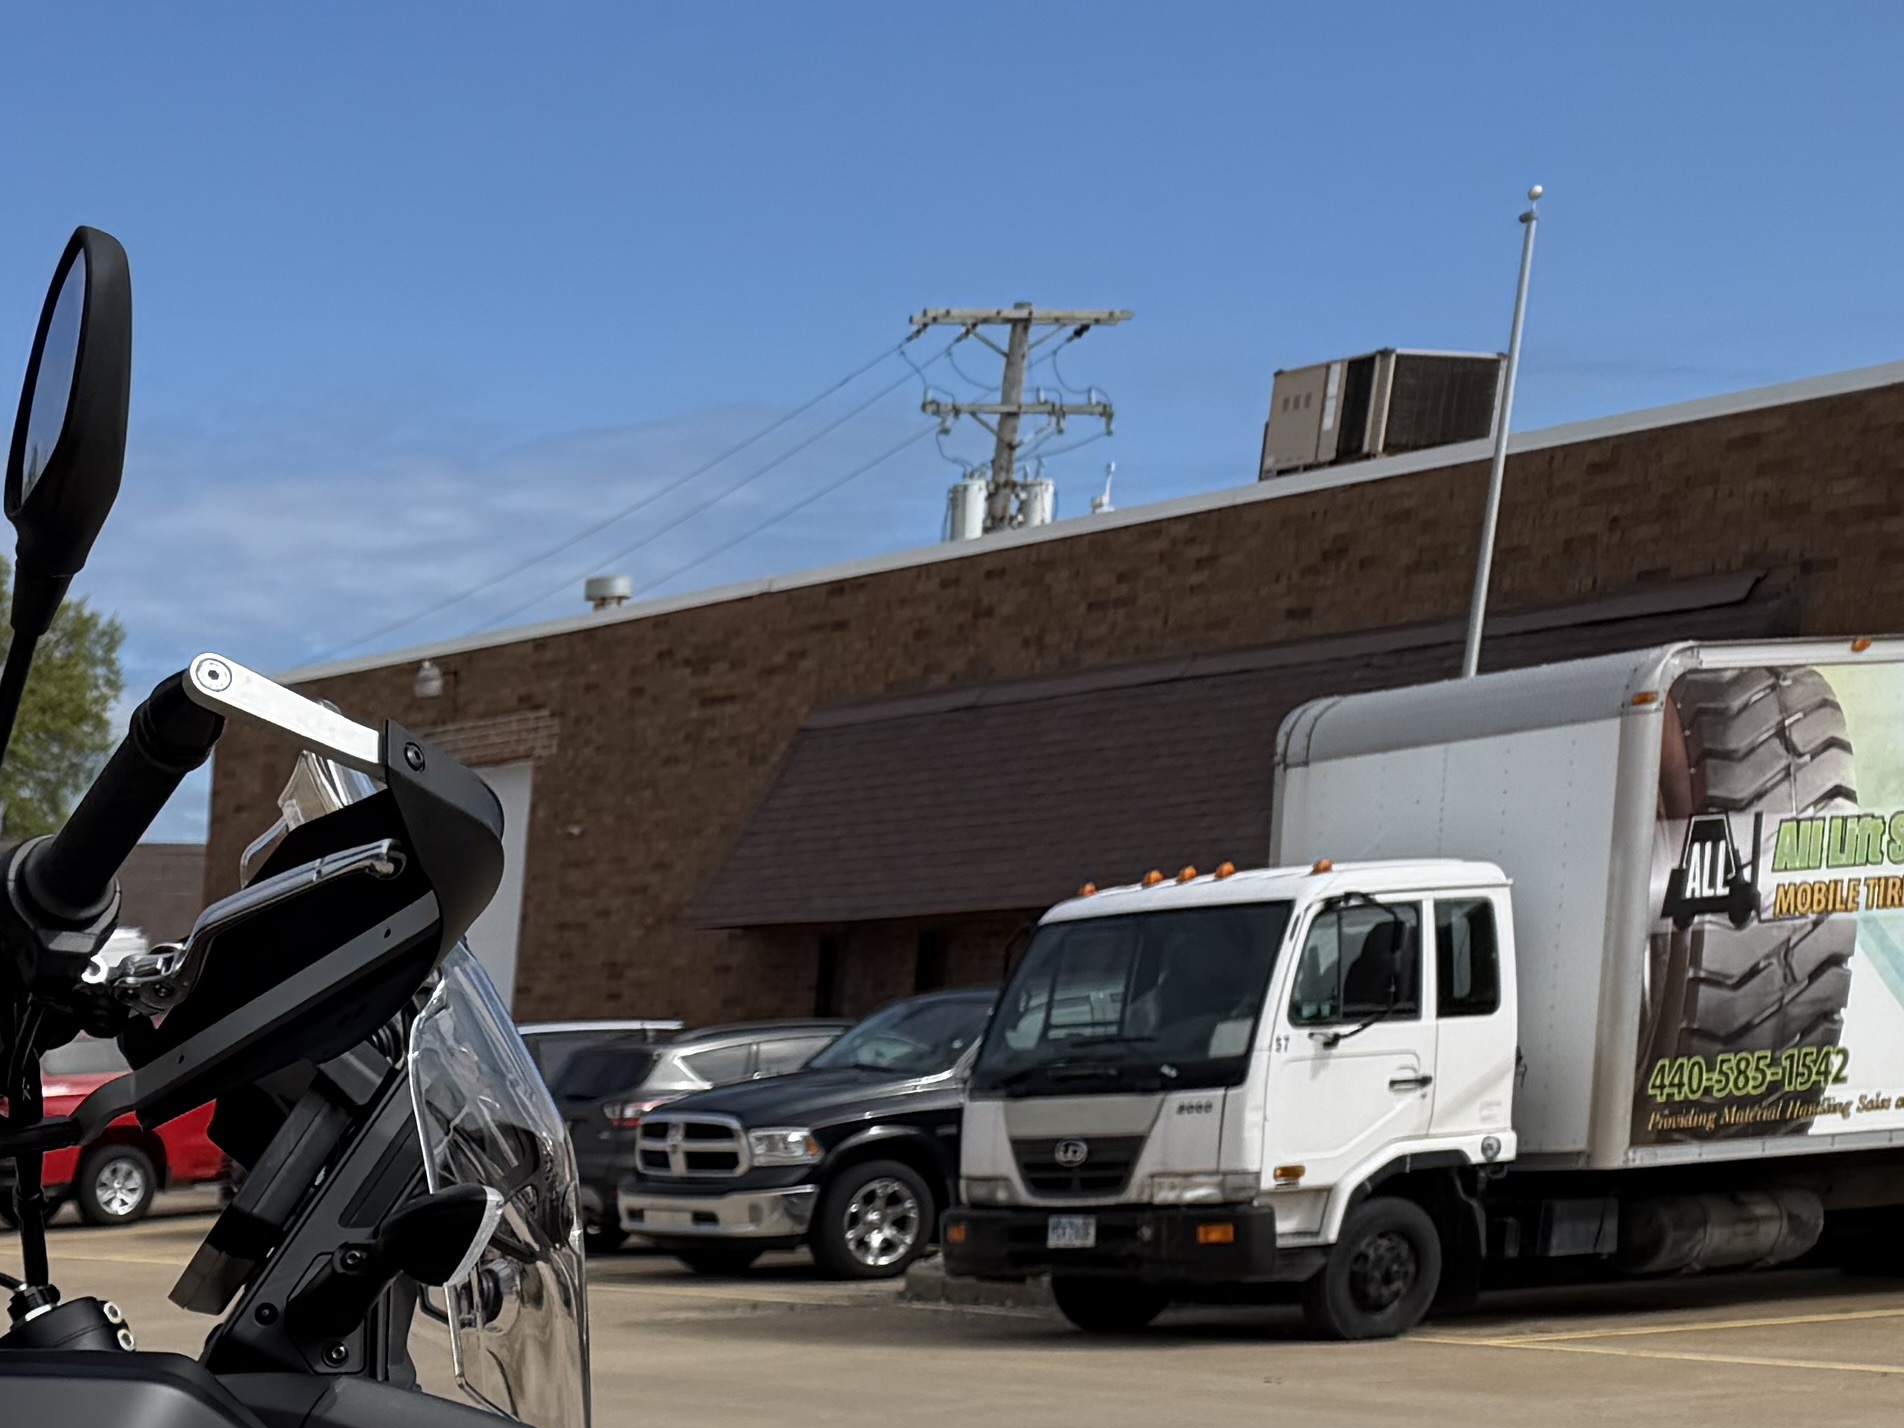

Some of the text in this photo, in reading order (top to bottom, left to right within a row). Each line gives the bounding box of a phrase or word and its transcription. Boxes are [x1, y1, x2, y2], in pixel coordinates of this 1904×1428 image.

[1685, 840, 1730, 898] ALL
[1771, 816, 1826, 873] All
[1826, 812, 1887, 869] Lift
[1773, 875, 1904, 919] MOBILE TIR
[1648, 1046, 1851, 1102] 440-585-1542
[1648, 1107, 1717, 1131] Providing
[1720, 1099, 1782, 1126] Material
[1786, 1096, 1852, 1121] Handling
